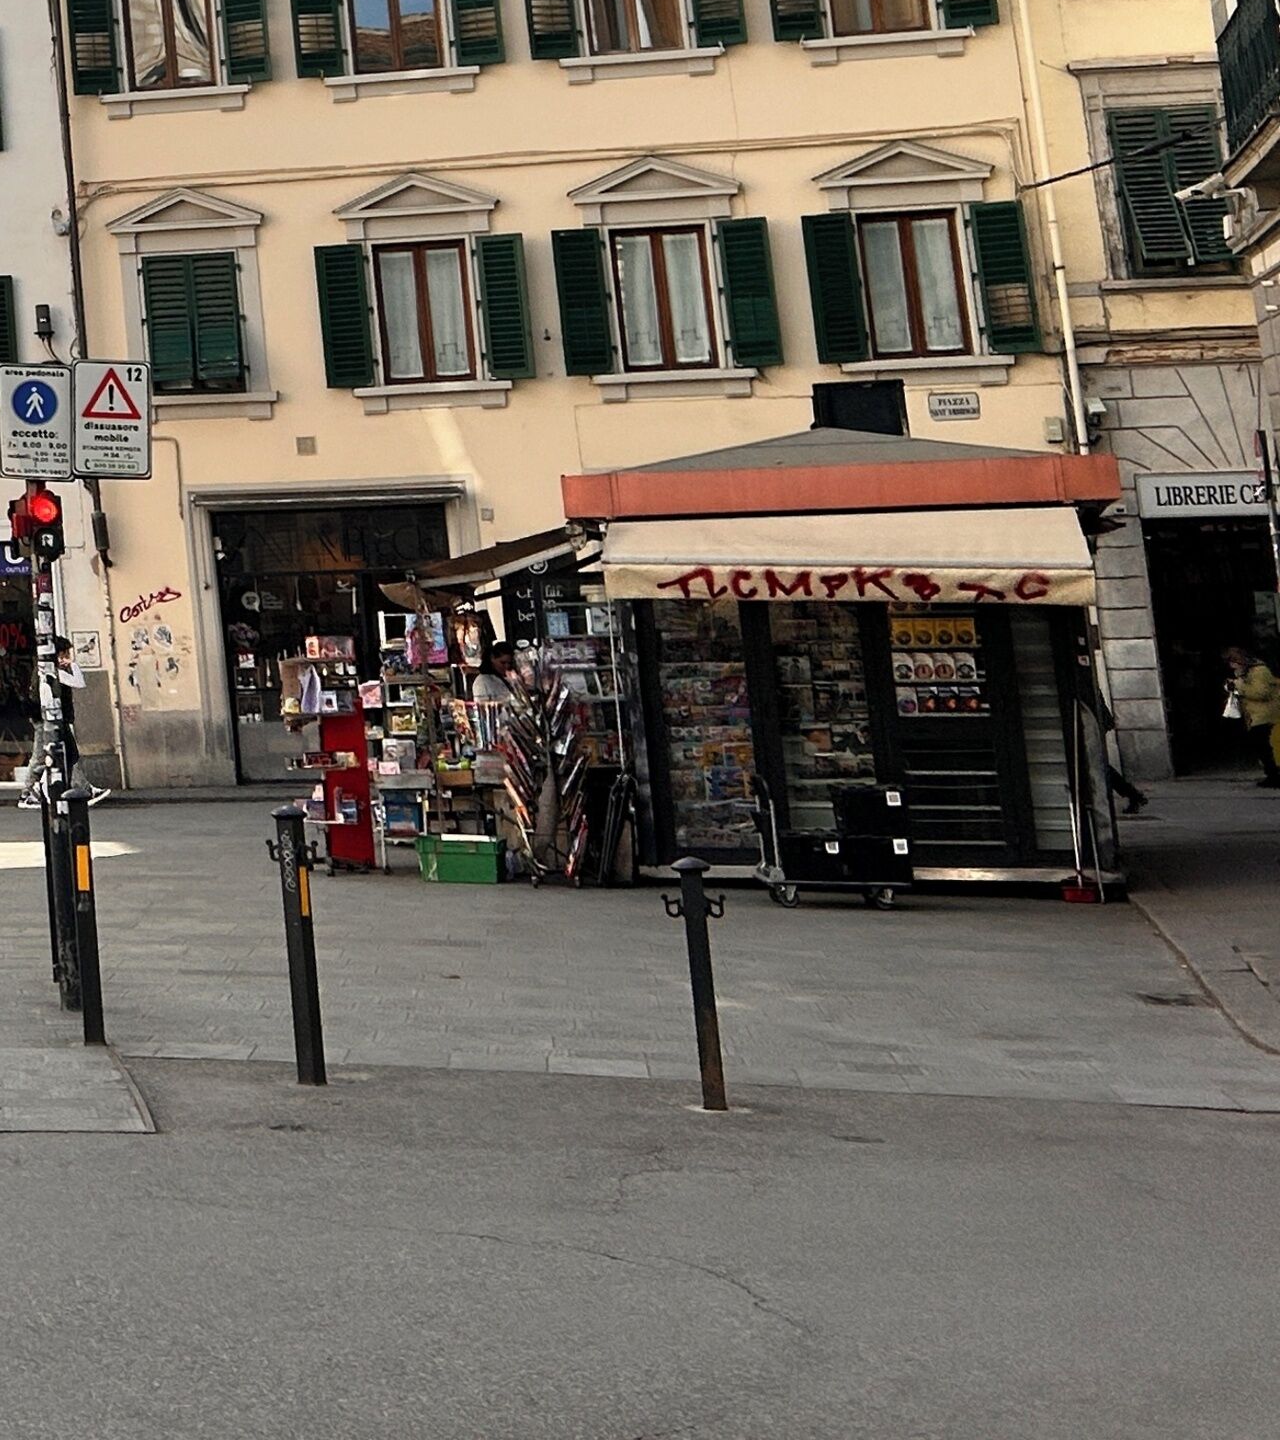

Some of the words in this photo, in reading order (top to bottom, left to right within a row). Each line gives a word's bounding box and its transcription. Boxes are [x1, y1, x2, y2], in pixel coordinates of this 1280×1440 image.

[26, 369, 65, 378] pedonale
[127, 367, 143, 382] 12
[84, 421, 139, 431] dissuasore
[12, 429, 58, 439] eccetto:
[94, 434, 129, 442] mobile
[1154, 484, 1238, 506] LIBRERIE
